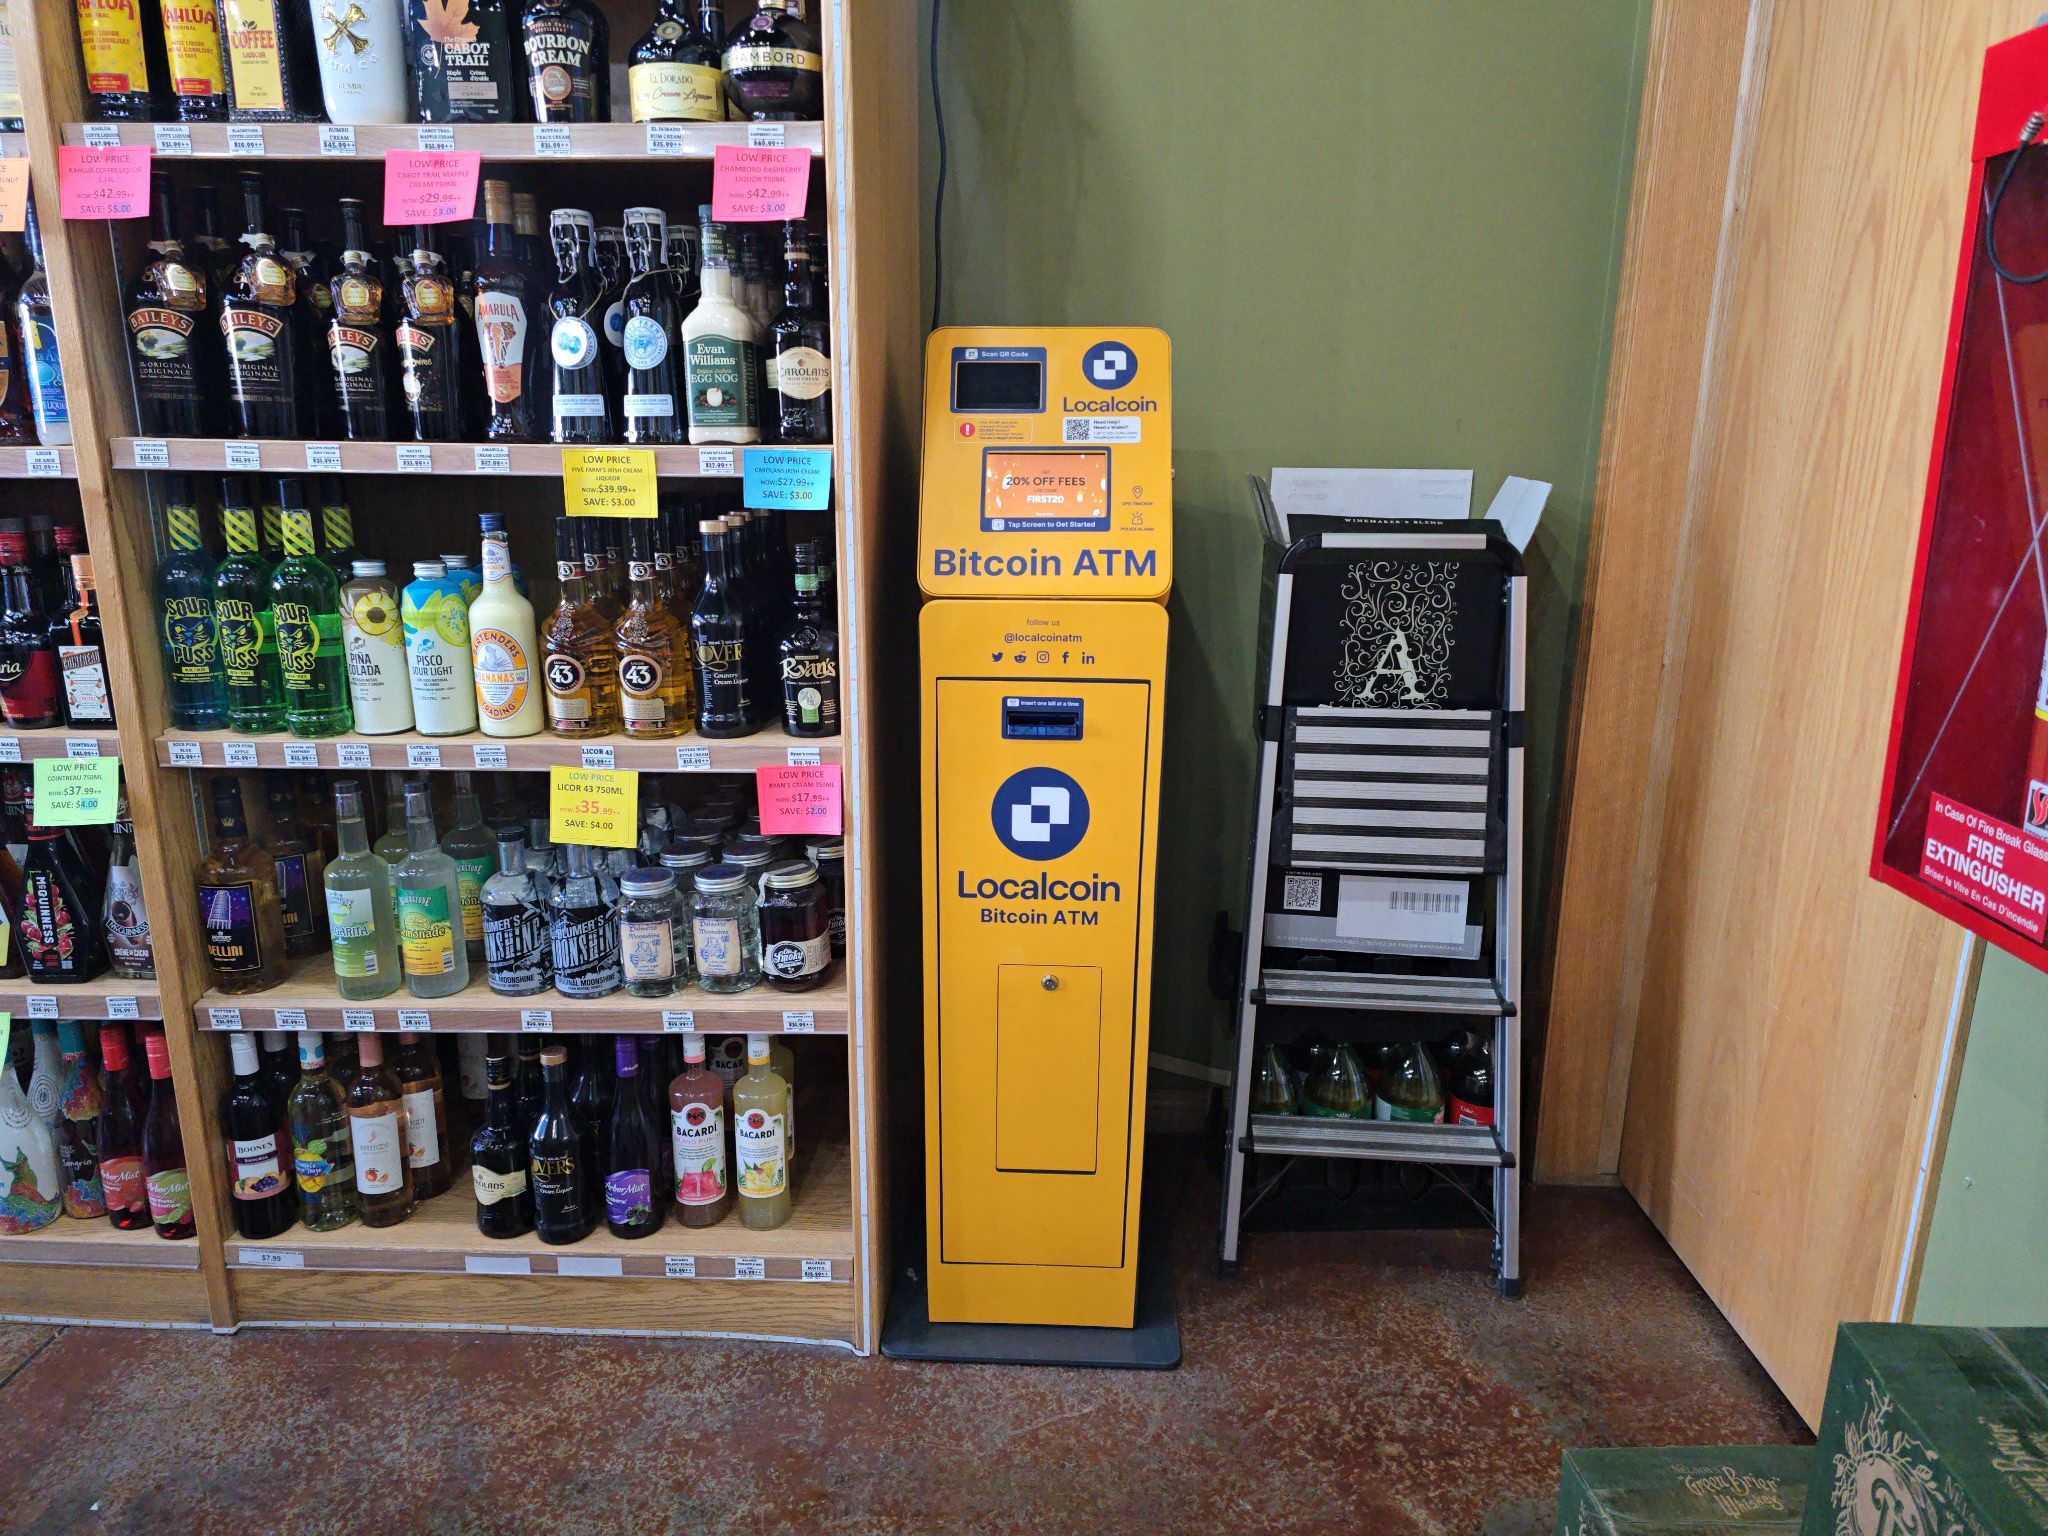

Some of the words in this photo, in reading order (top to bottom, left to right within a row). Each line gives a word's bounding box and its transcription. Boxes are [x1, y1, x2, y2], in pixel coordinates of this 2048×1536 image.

[231, 30, 274, 49] COFFEE
[524, 34, 590, 56] BOURBON
[444, 43, 490, 55] CABOT
[445, 54, 488, 66] TRAIL
[530, 50, 581, 67] CREAM
[81, 154, 102, 163] LOW
[105, 154, 130, 163] PRICE
[410, 160, 434, 168] LOW
[434, 160, 459, 168] PRICE
[736, 153, 759, 162] LOW
[761, 154, 788, 163] PRICE
[80, 205, 105, 214] SAVE:
[108, 204, 131, 214] $5.00
[405, 208, 431, 217] SAVE:
[432, 208, 457, 217] $3.00
[732, 204, 759, 213] SAVE:
[760, 204, 786, 213] $3.00
[131, 311, 190, 329] BAILEYS
[696, 343, 725, 354] Evan
[982, 350, 999, 358] Scan
[147, 362, 192, 370] ORIGINAL
[689, 354, 736, 366] Williams
[691, 374, 713, 383] EGG
[714, 374, 739, 383] NOG
[1063, 396, 1158, 413] Localcoin
[583, 455, 604, 464] LOW
[606, 456, 631, 464] PRICE
[763, 456, 785, 464] LOW
[787, 456, 812, 465] PRICE
[1006, 476, 1030, 486] 20%
[1033, 477, 1055, 486] OFF
[1058, 477, 1086, 486] FEES
[762, 490, 788, 499] SAVE:
[790, 490, 813, 500] $3.00
[1026, 495, 1065, 504] FIRST20
[584, 498, 609, 506] SAVE:
[611, 498, 636, 507] $3.00
[934, 548, 1062, 576] Bitcoin
[1073, 549, 1157, 576] ATM
[165, 597, 210, 617] SOUR
[216, 600, 253, 620] SOUR
[273, 602, 310, 623] SOUR
[1026, 618, 1049, 626] follow
[1004, 633, 1083, 644] @localcoinatm
[474, 632, 520, 658] BARTENDERS
[174, 644, 215, 666] PUSS
[224, 648, 259, 669] PUSS
[350, 651, 372, 665] PIÑA
[416, 654, 443, 666] PISCO
[281, 652, 316, 673] PUSS
[412, 666, 429, 676] SOUR
[430, 666, 453, 676] LIGHT
[550, 665, 574, 684] 43
[626, 666, 651, 685] 43
[780, 658, 836, 681] Ryan's
[479, 672, 515, 683] BANANAS
[582, 748, 604, 756] LICOR
[53, 764, 72, 772] LOW
[569, 772, 589, 780] LOW
[591, 774, 615, 782] PRICE
[779, 771, 799, 779] LOW
[801, 770, 824, 779] PRICE
[557, 784, 582, 792] LICOR
[596, 786, 624, 795] 750ML
[51, 801, 74, 809] SAVE:
[76, 800, 98, 809] $4.00
[780, 807, 803, 815] SAVE:
[806, 807, 828, 815] $2.00
[565, 820, 588, 828] SAVE:
[590, 821, 613, 830] $4.00
[1935, 800, 1943, 812] In
[1944, 803, 1965, 823] Case
[1966, 814, 1978, 829] Of
[1978, 818, 1994, 837] Fire
[1996, 825, 2021, 850] Break
[2023, 835, 2048, 862] Glass
[1966, 833, 2006, 868] FIRE
[1925, 838, 2046, 915] EXTINGUISHER
[958, 870, 1121, 902] Localcoin
[1924, 865, 1945, 882] Briser
[1953, 880, 1970, 897] Vitre
[1970, 887, 1981, 900] En
[1982, 894, 1997, 910] Cas
[1998, 901, 2039, 933] D'incendie
[980, 908, 1048, 925] Bitcoin
[1053, 910, 1099, 925] ATM
[208, 945, 243, 956] BELLINI
[773, 951, 803, 963] Smoky
[580, 974, 617, 987] MOONSHINE
[676, 1121, 717, 1138] BACARDÍ
[740, 1127, 775, 1139] BACARDÍ
[117, 1170, 140, 1182] Mist
[604, 1182, 626, 1195] Arbor
[625, 1181, 648, 1195] Mist
[262, 1254, 282, 1263] $7.99
